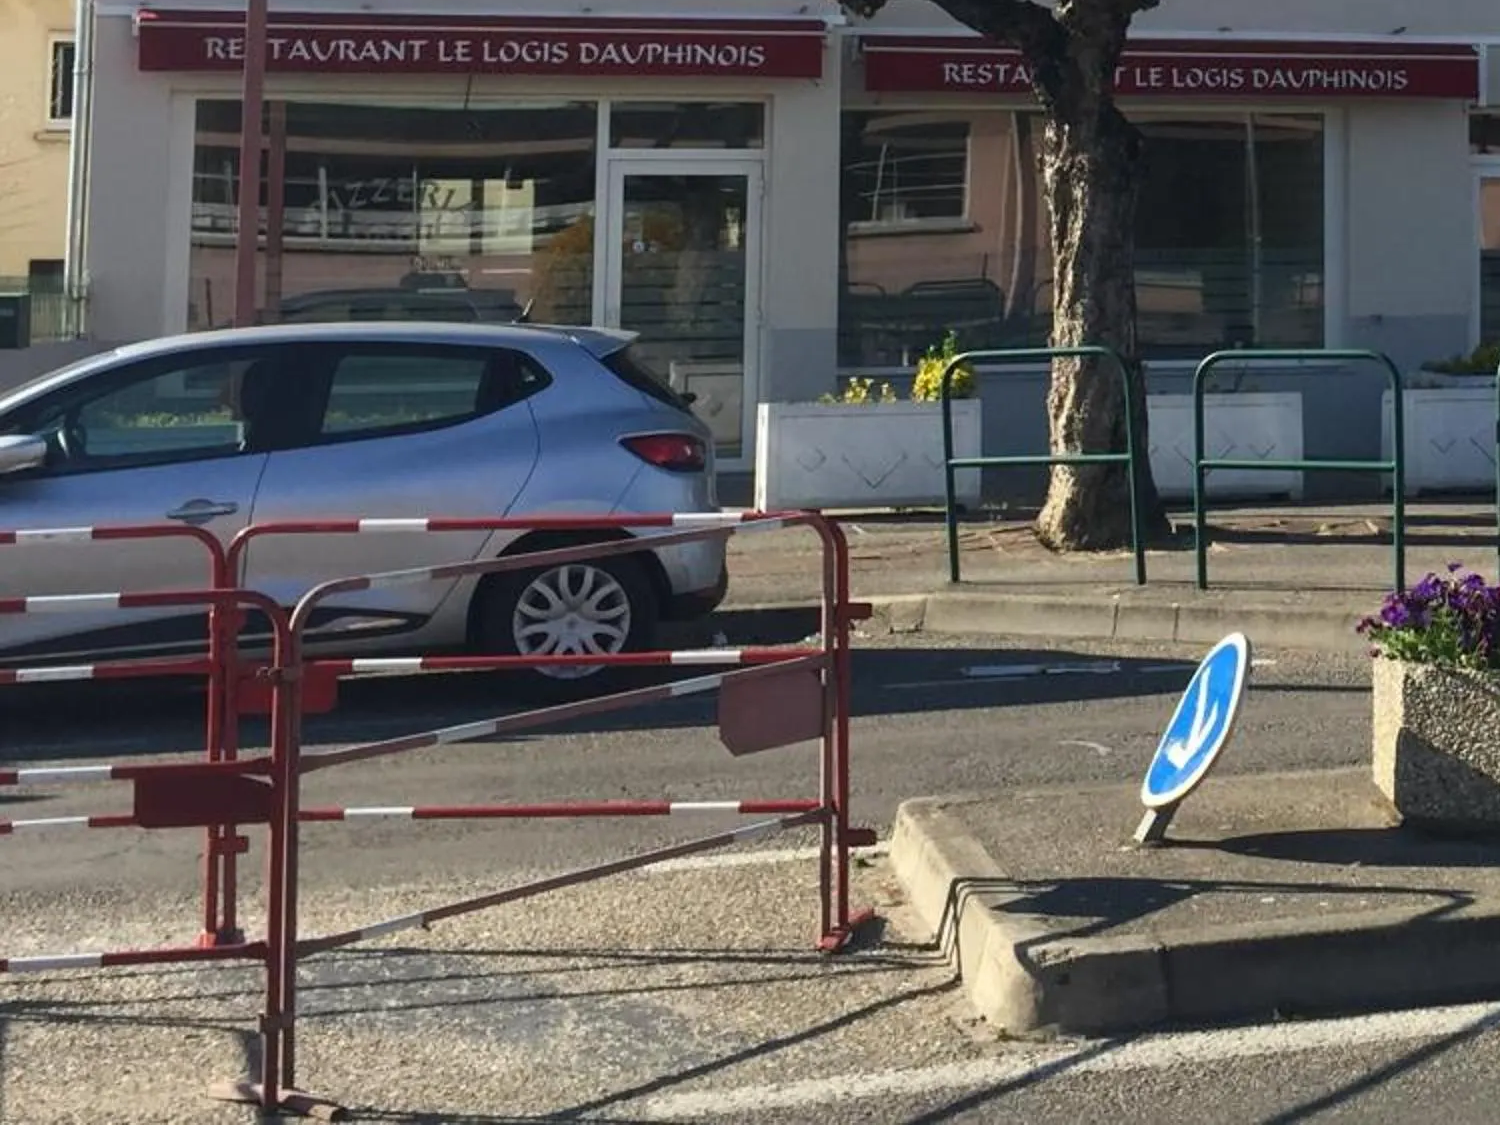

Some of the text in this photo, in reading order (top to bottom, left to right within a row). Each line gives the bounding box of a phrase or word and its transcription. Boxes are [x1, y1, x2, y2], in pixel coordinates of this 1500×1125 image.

[204, 36, 766, 67] RETAURANT LE LOGIS DAUPHINOIS
[943, 62, 1409, 90] RESTAT LE LOGIS DAUPHINOIS
[305, 176, 478, 219] IZZERI
